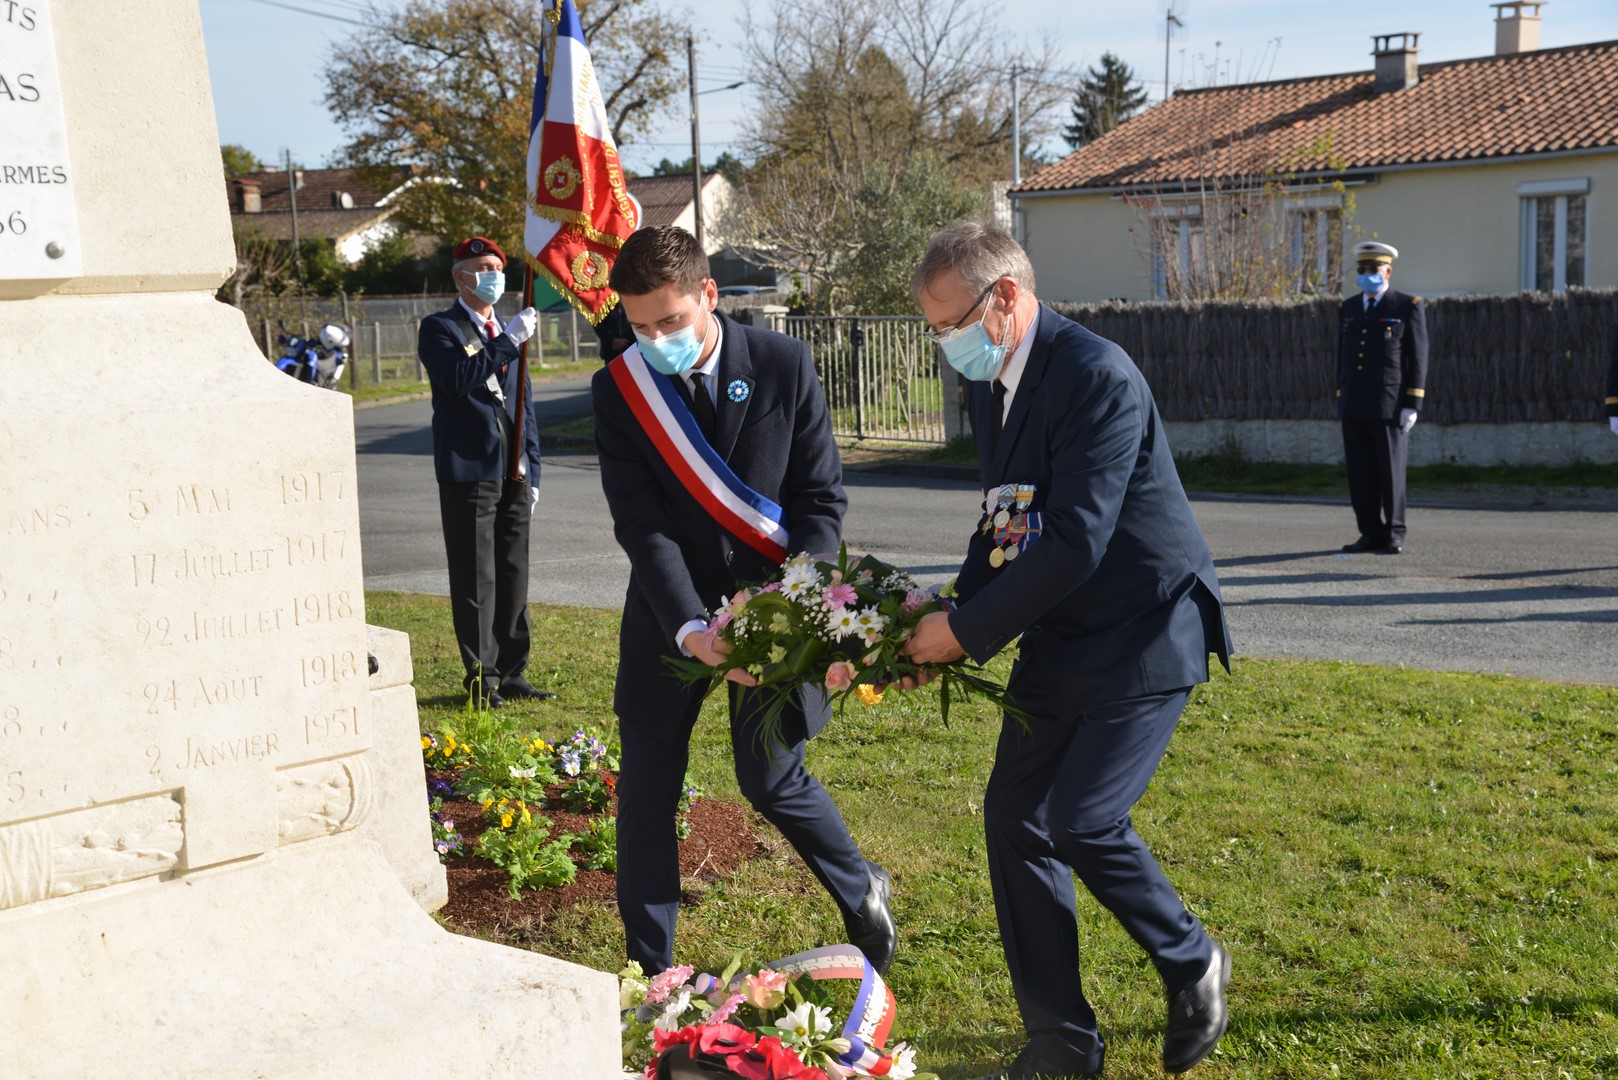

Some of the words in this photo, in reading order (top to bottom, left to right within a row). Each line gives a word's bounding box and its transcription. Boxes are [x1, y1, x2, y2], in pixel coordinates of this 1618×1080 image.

[0, 165, 68, 184] RMES
[279, 471, 346, 506] 1917
[131, 553, 157, 587] 17
[286, 530, 348, 567] 1917
[293, 590, 353, 627] 1918
[176, 733, 279, 770] JANVIER
